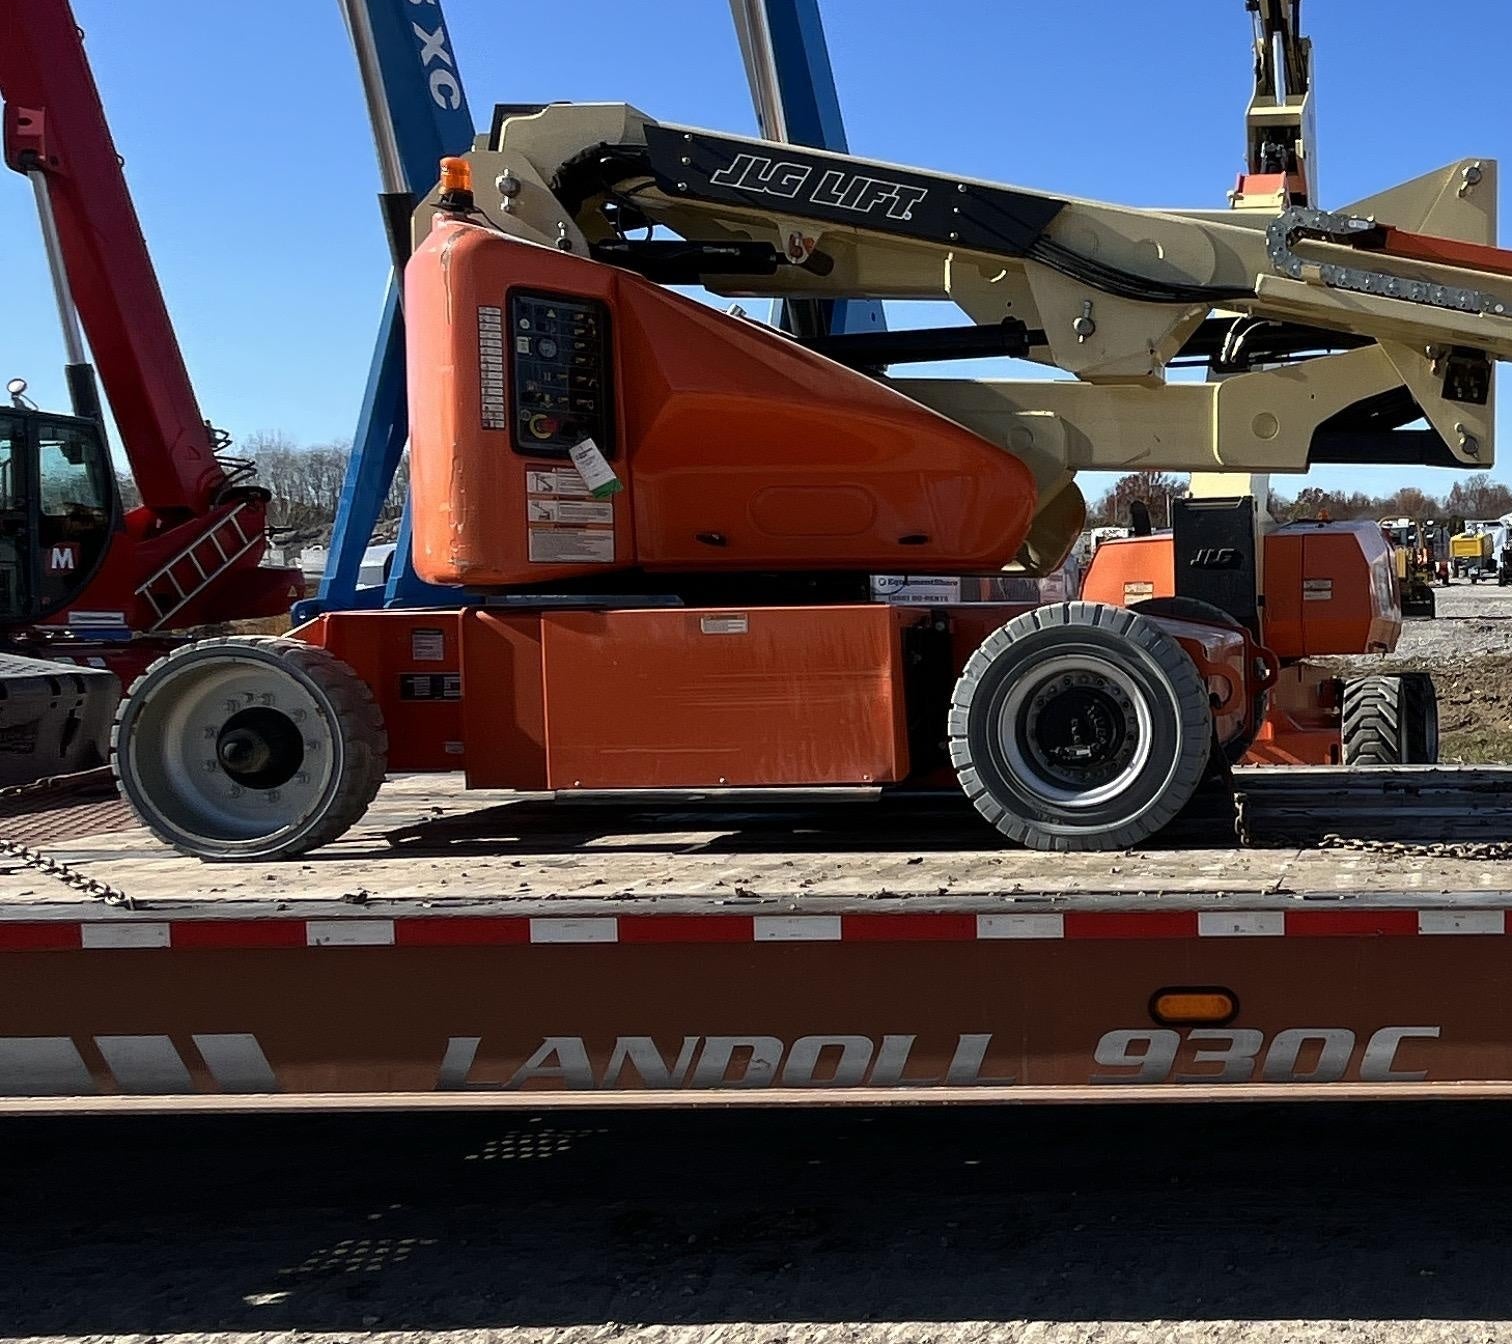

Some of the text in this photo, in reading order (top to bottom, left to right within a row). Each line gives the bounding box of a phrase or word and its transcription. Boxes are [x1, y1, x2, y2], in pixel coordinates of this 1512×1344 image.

[413, 23, 461, 111] XC
[710, 153, 928, 220] JLG LIFT
[435, 1025, 1442, 1090] LANDOLL 930C
